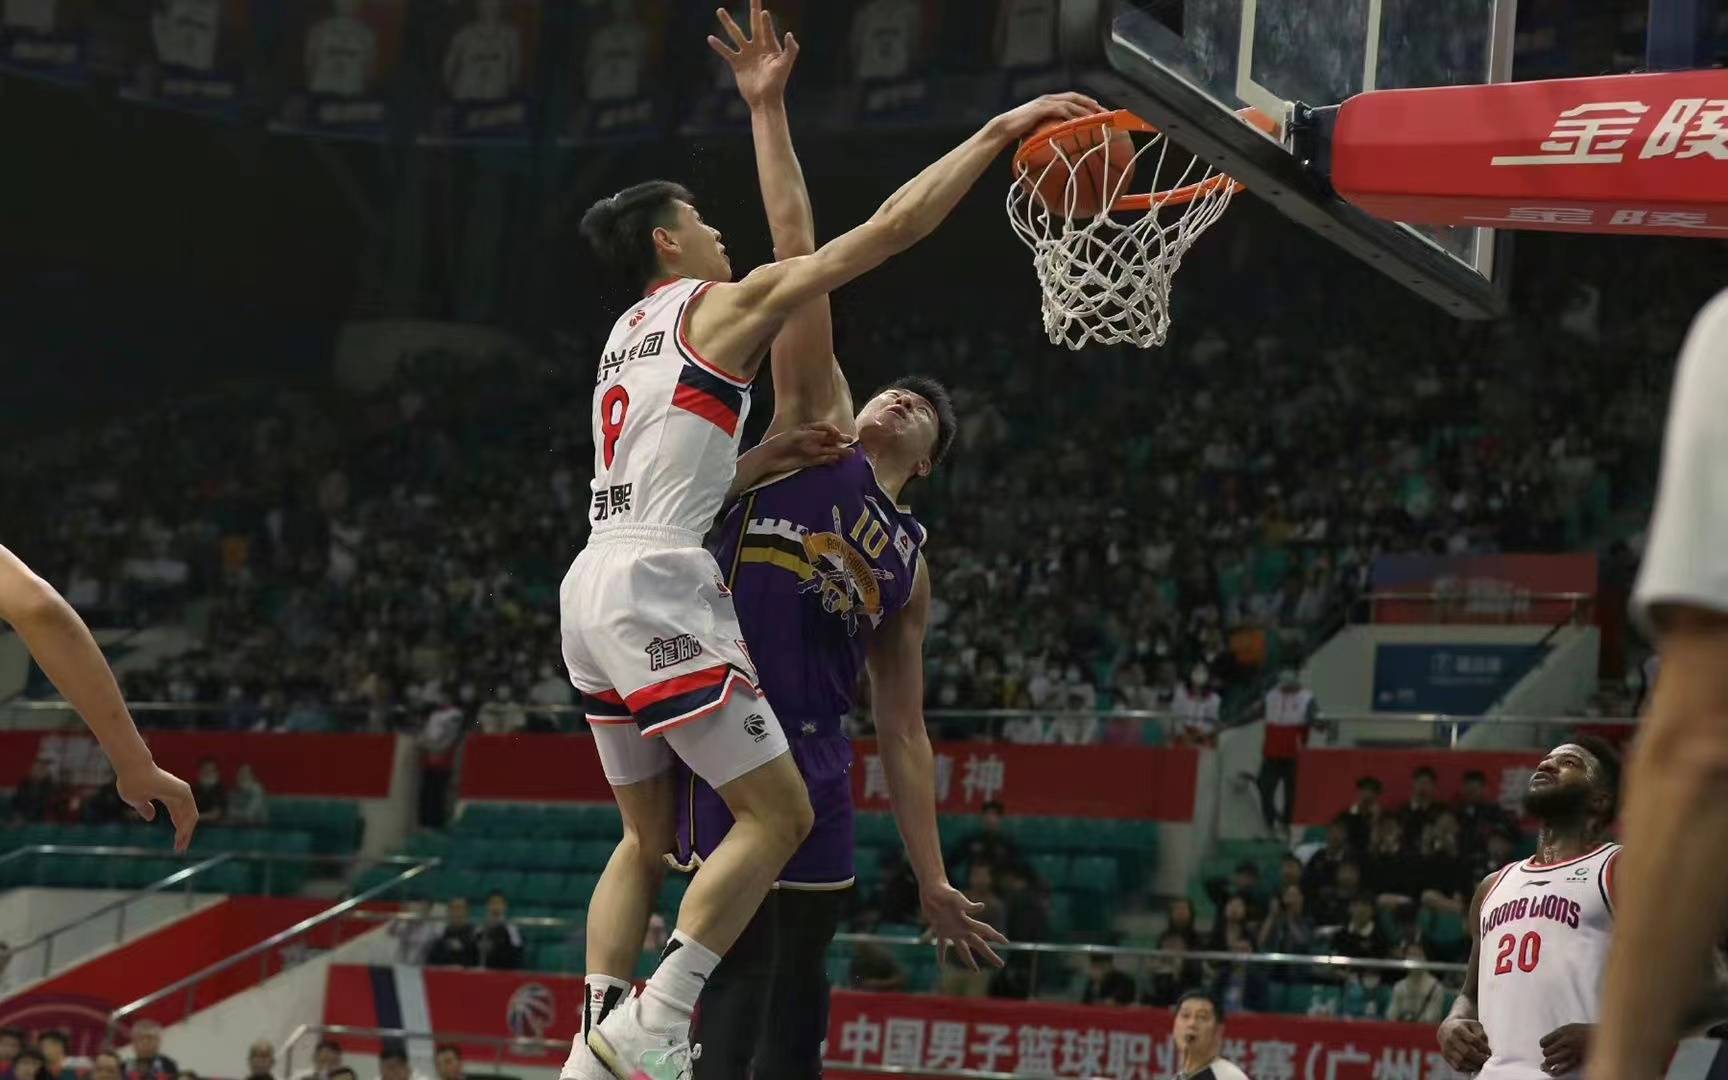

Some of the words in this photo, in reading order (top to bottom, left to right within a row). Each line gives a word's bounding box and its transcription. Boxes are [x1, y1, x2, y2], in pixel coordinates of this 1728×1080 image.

[1490, 98, 1728, 166] 金陵
[1463, 207, 1710, 229] 金陵
[849, 503, 890, 560] 10
[1494, 930, 1542, 976] 20
